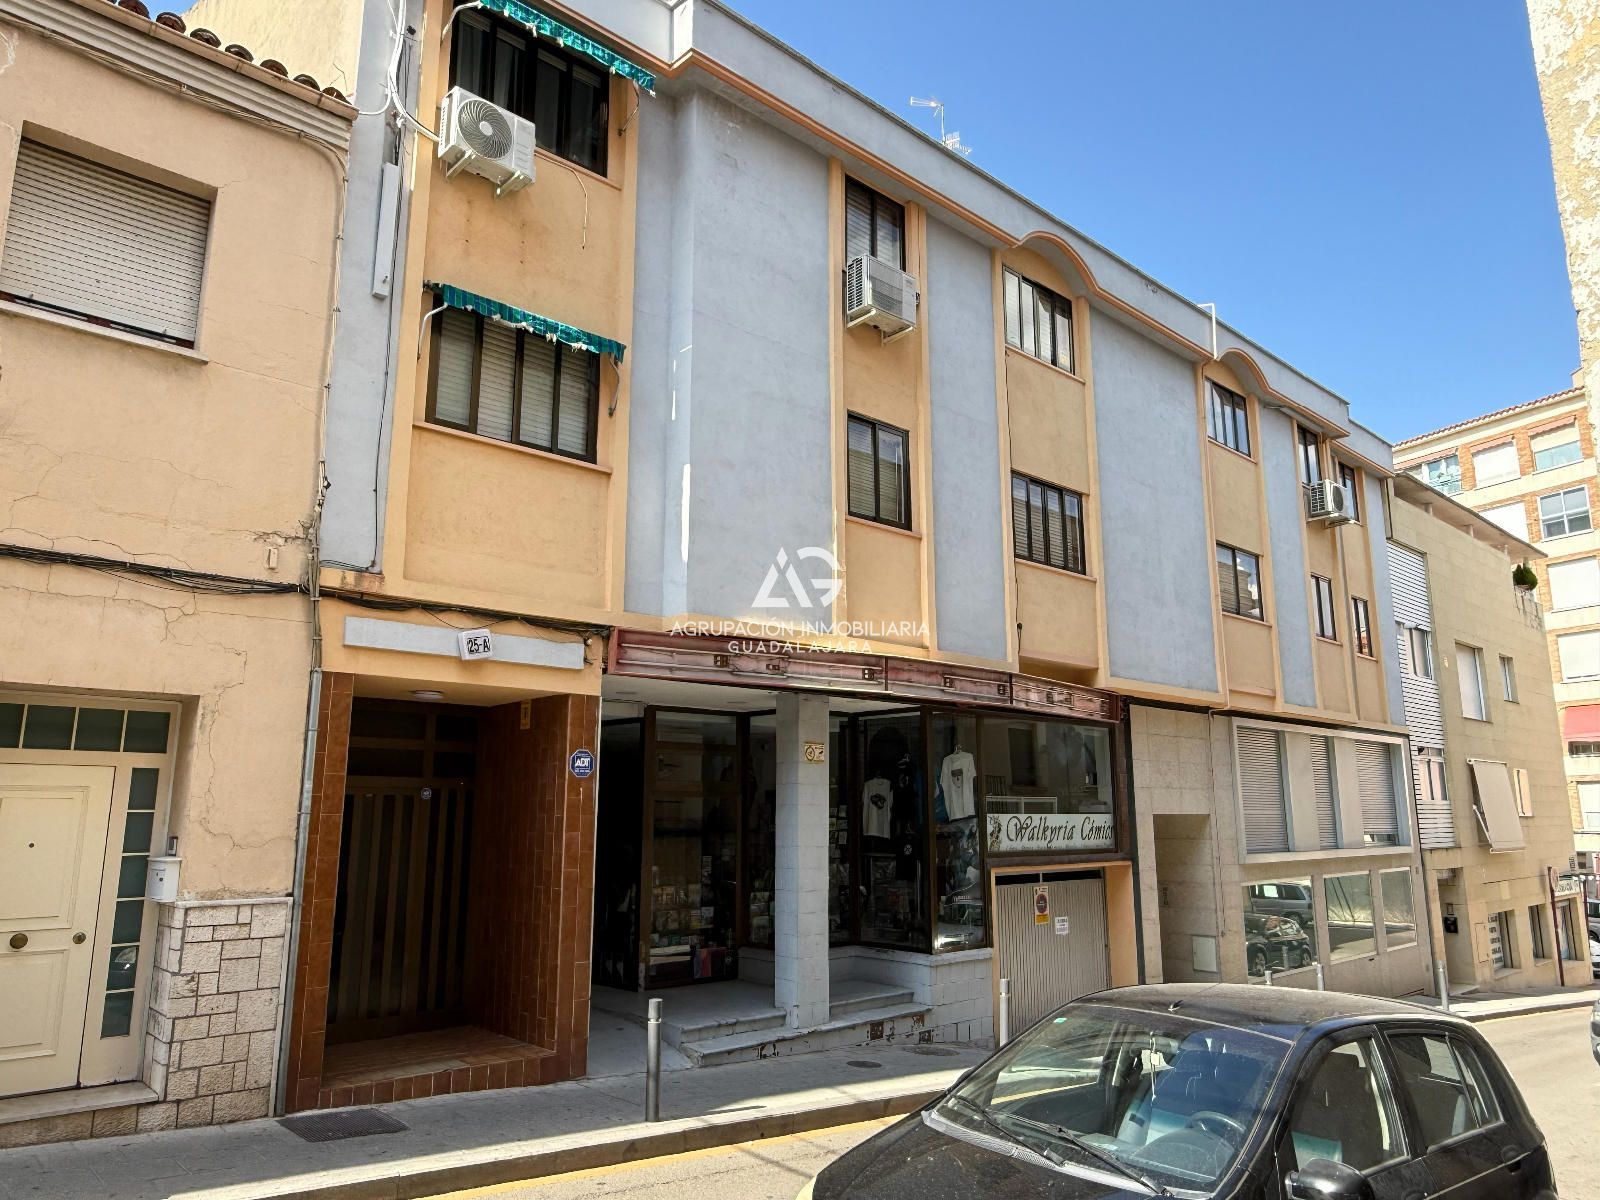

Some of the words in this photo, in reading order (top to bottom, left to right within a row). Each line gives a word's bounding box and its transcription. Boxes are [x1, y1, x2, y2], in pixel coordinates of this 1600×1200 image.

[468, 638, 489, 653] 25-A
[575, 758, 591, 767] ADT
[1006, 815, 1076, 849] Walkyria
